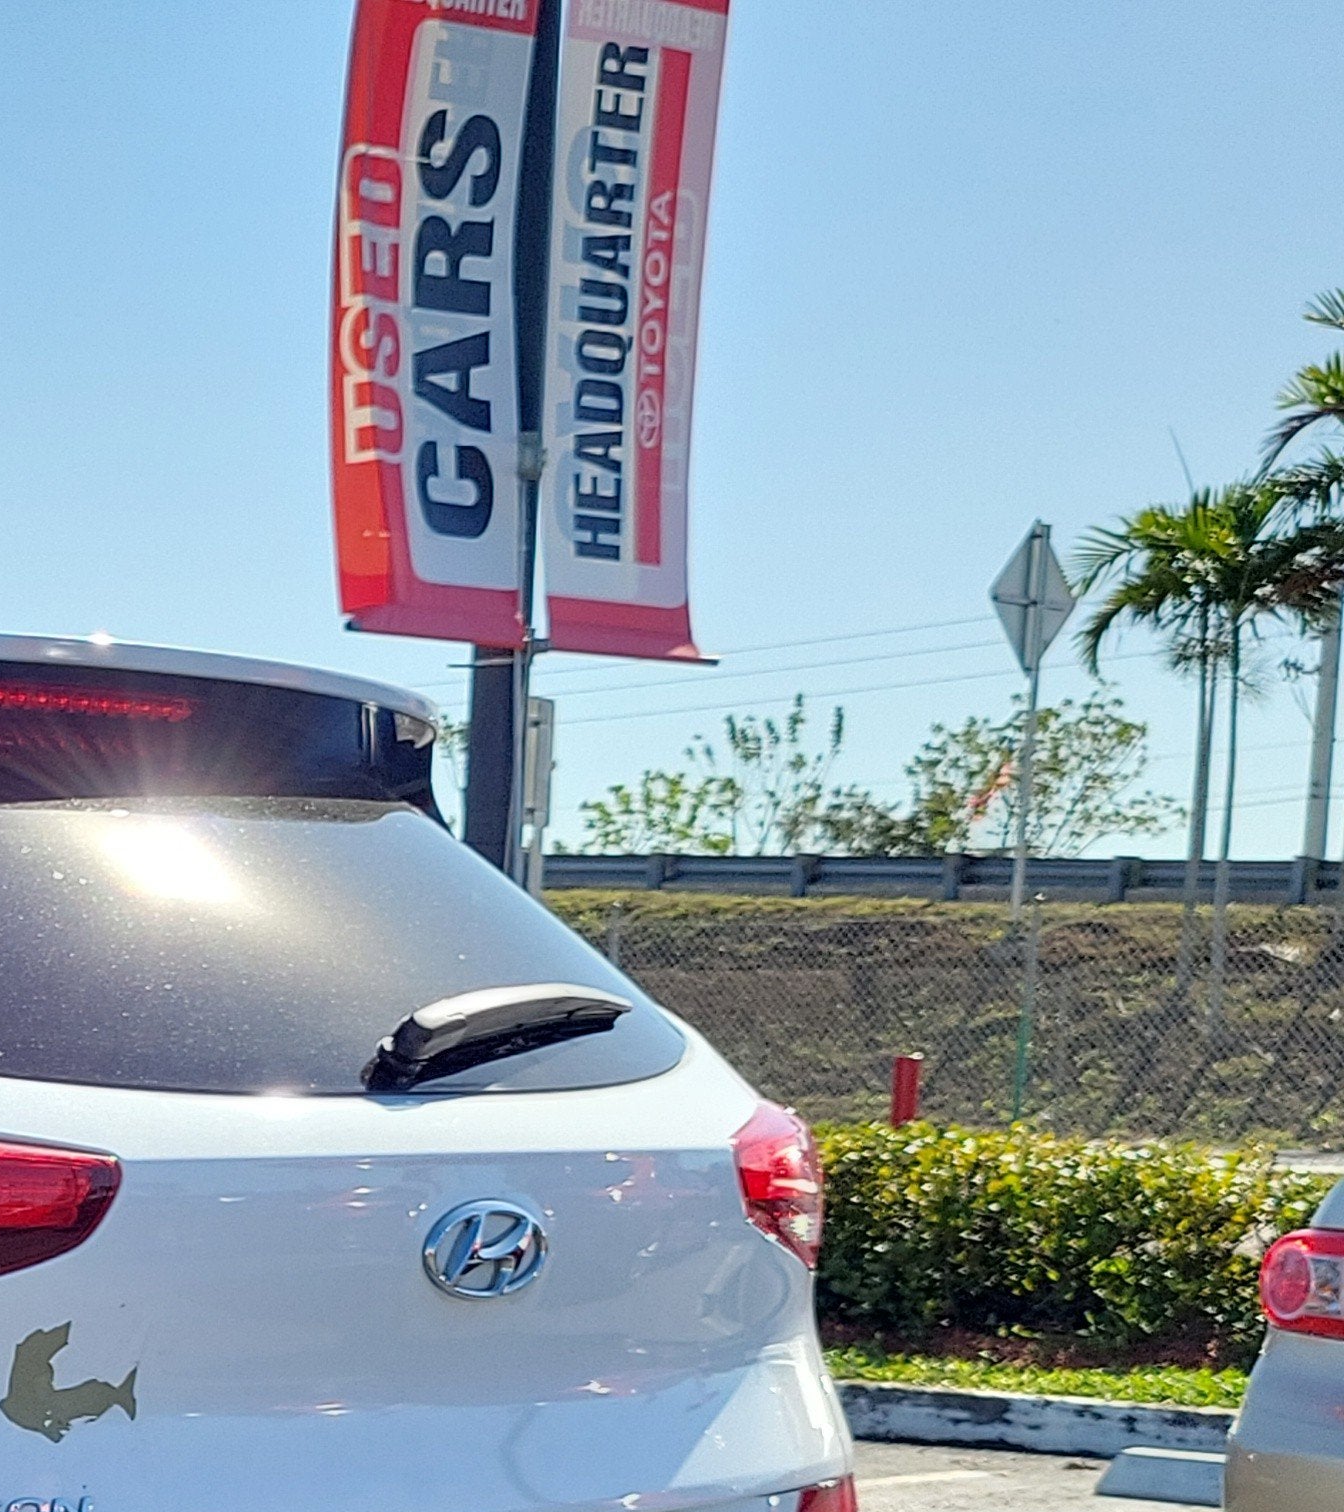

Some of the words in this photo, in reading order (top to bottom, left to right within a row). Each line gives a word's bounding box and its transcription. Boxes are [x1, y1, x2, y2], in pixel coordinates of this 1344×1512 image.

[340, 143, 405, 464] USED
[414, 108, 502, 540] CARS
[573, 42, 649, 562] HEADQUARTER
[639, 190, 674, 381] TOYOTA
